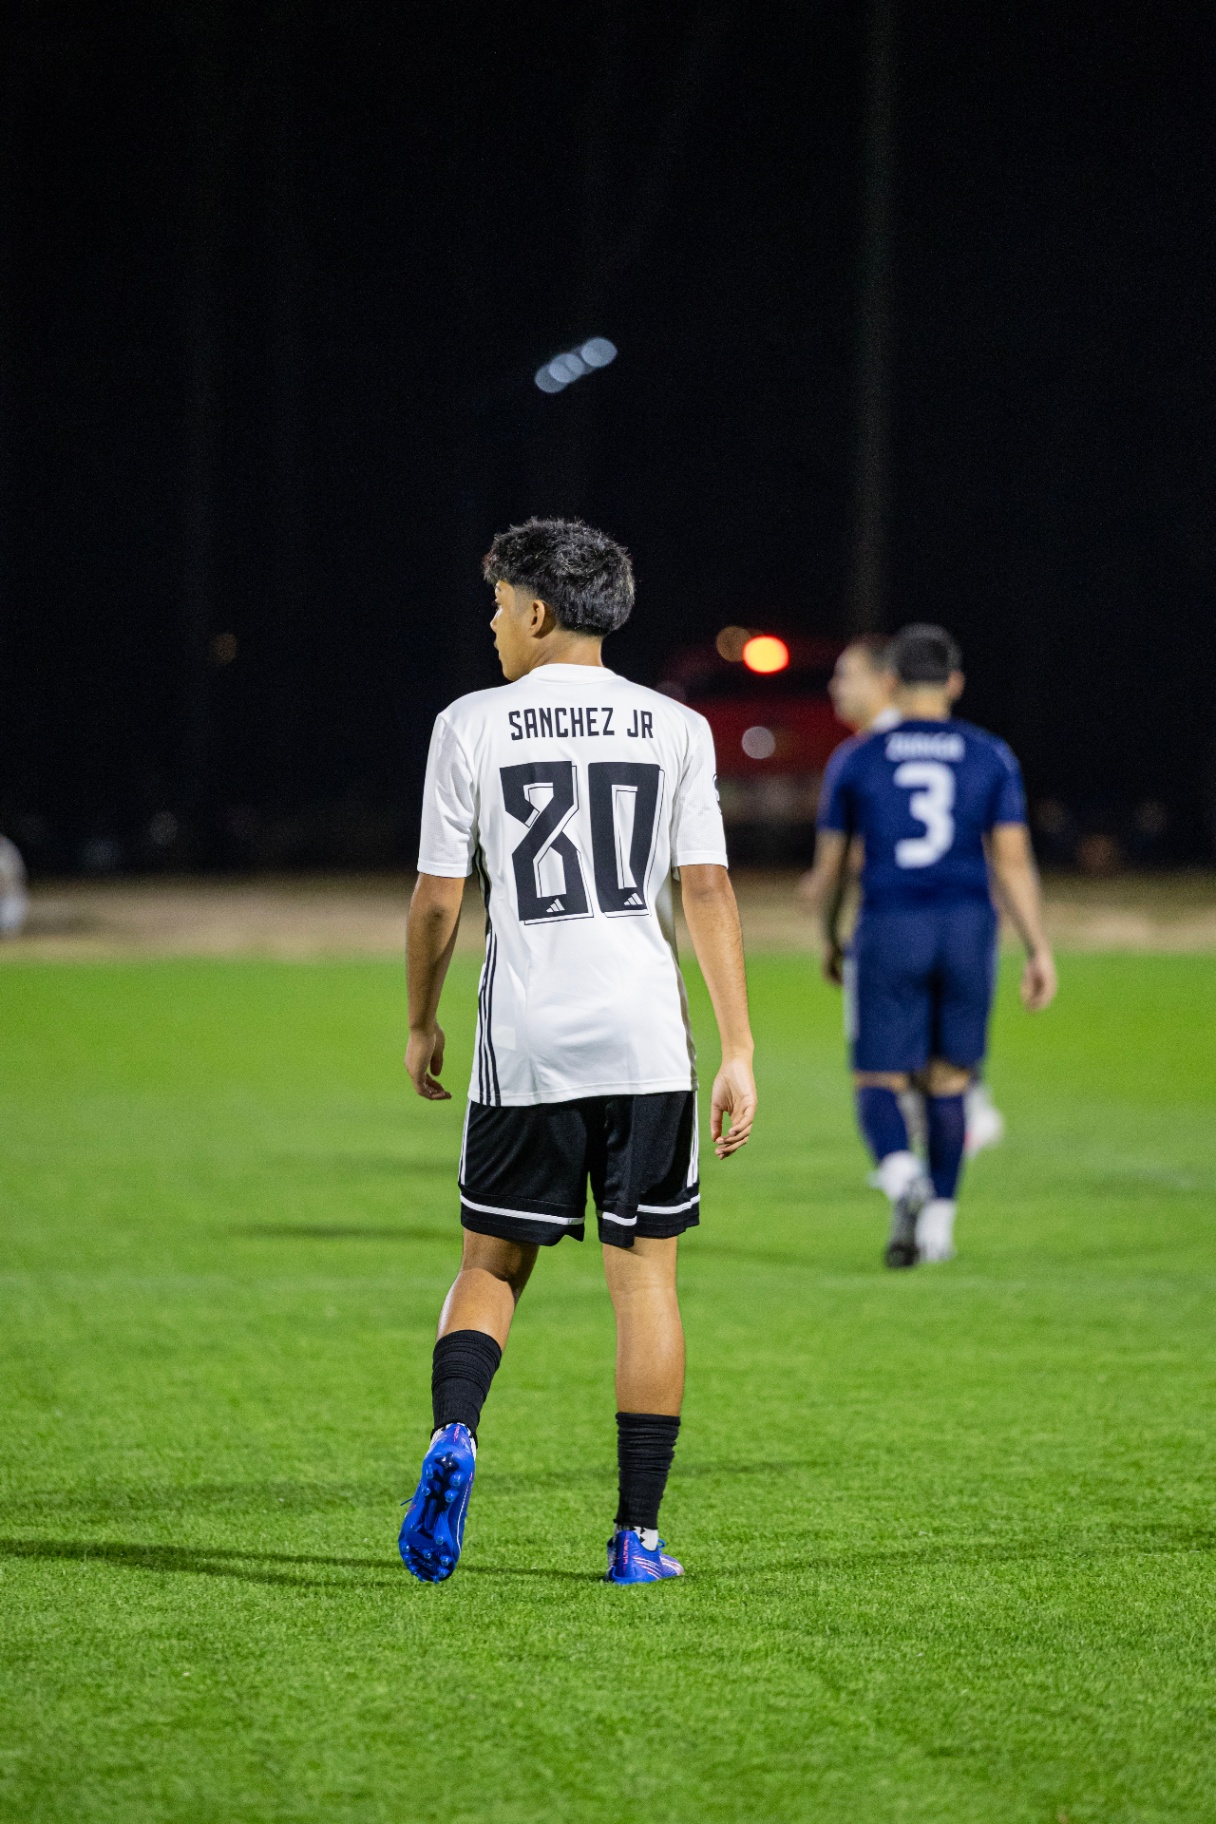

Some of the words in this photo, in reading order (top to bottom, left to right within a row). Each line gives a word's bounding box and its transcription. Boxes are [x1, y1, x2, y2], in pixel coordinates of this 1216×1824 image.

[508, 707, 615, 740] SANCHEZ
[627, 709, 654, 739] JR
[499, 761, 665, 925] 80
[893, 760, 956, 869] 3
